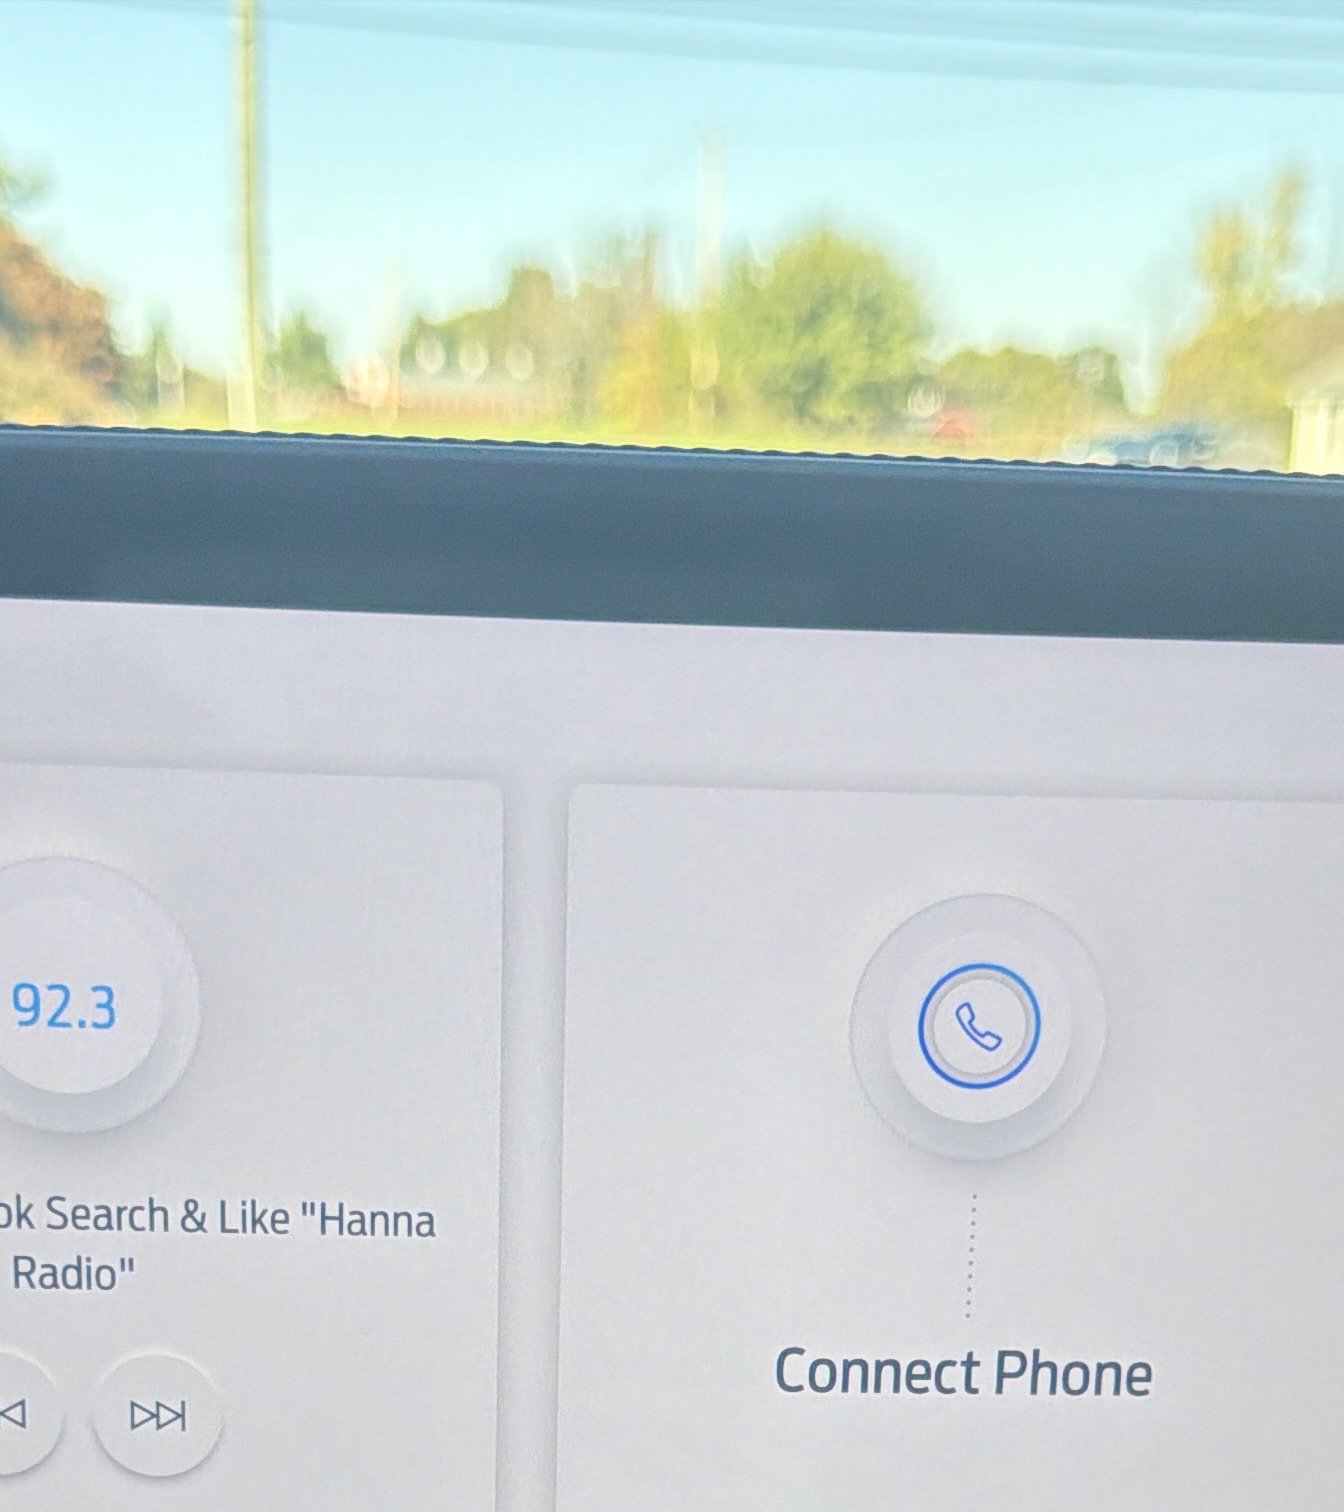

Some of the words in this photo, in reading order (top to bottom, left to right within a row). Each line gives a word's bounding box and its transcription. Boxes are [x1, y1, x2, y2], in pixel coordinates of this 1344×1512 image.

[10, 981, 117, 1030] 92.3
[46, 1195, 170, 1233] Search
[179, 1198, 209, 1234] &
[219, 1199, 290, 1235] Like
[301, 1201, 436, 1238] "Hanna
[12, 1254, 136, 1291] Radio"
[775, 1346, 981, 1395] Connect
[994, 1348, 1153, 1397] Phone
